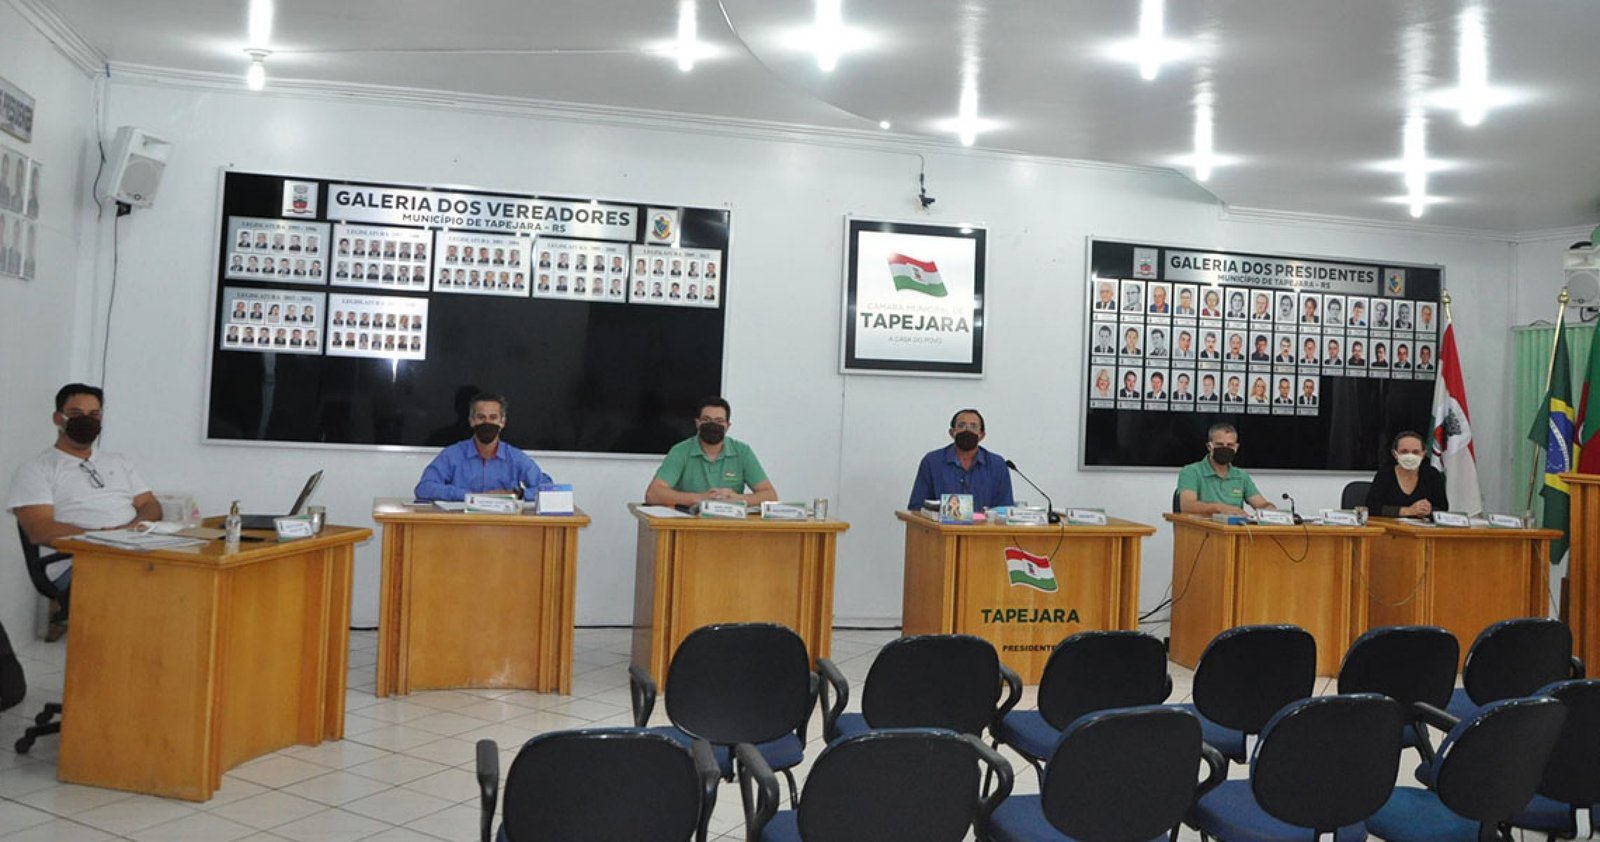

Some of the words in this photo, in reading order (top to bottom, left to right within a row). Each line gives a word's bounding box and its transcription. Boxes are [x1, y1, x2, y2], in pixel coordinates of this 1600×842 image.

[336, 191, 431, 212] GALERIA
[438, 198, 482, 215] DOS
[487, 201, 631, 227] VEREADORES
[403, 213, 464, 226] MUNICÍPIO
[467, 217, 482, 227] DE
[484, 219, 542, 232] TAPEJARA
[552, 223, 567, 233] RS
[1171, 256, 1238, 273] GALERIA
[1242, 261, 1273, 276] DOS
[1275, 264, 1375, 283] PRESIDENTES
[1262, 277, 1273, 285] DE
[1274, 278, 1315, 289] TAPEJARA
[860, 312, 970, 333] TAPEJARA
[981, 608, 1081, 624] TAPEJARA
